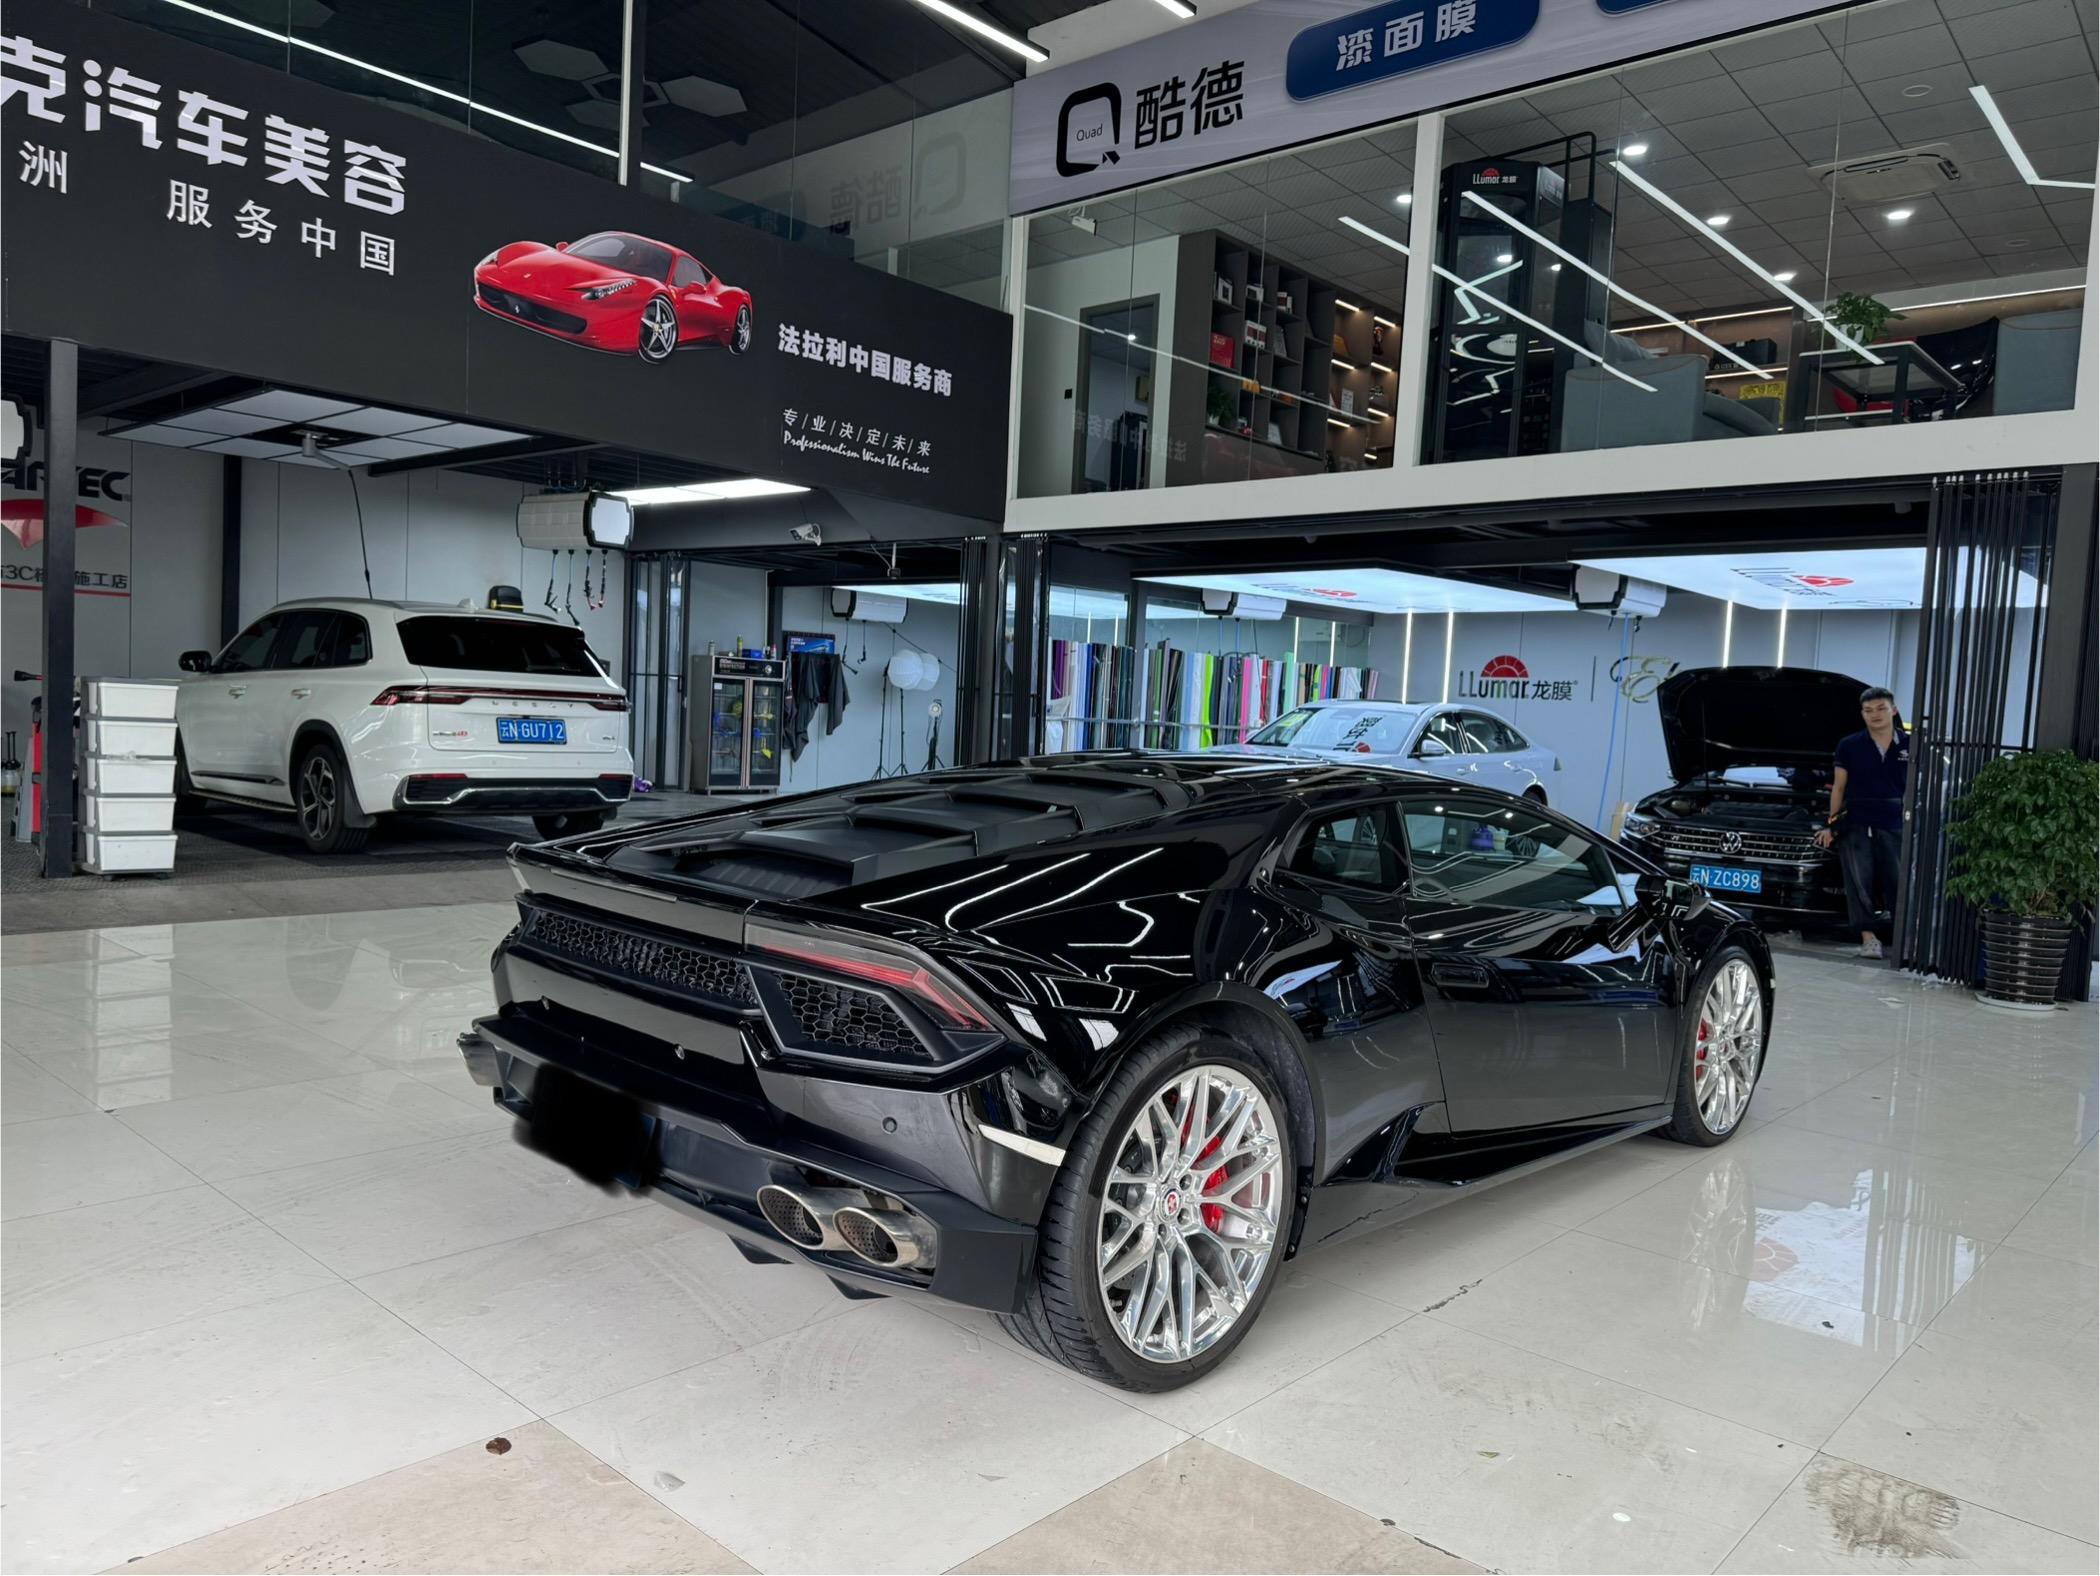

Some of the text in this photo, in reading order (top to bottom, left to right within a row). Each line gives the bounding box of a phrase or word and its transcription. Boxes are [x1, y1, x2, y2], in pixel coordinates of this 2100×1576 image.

[1336, 0, 1477, 71] 漆面膜
[1, 35, 407, 216] 克汽车美容
[1076, 123, 1103, 142] Quad
[1135, 60, 1245, 149] 酷德
[18, 141, 395, 276] 洲 服务中国
[777, 322, 952, 397] 法拉利中国服务商
[783, 430, 930, 474] Professionalism Wins The Future
[1458, 670, 1573, 701] LLumar 龙膜
